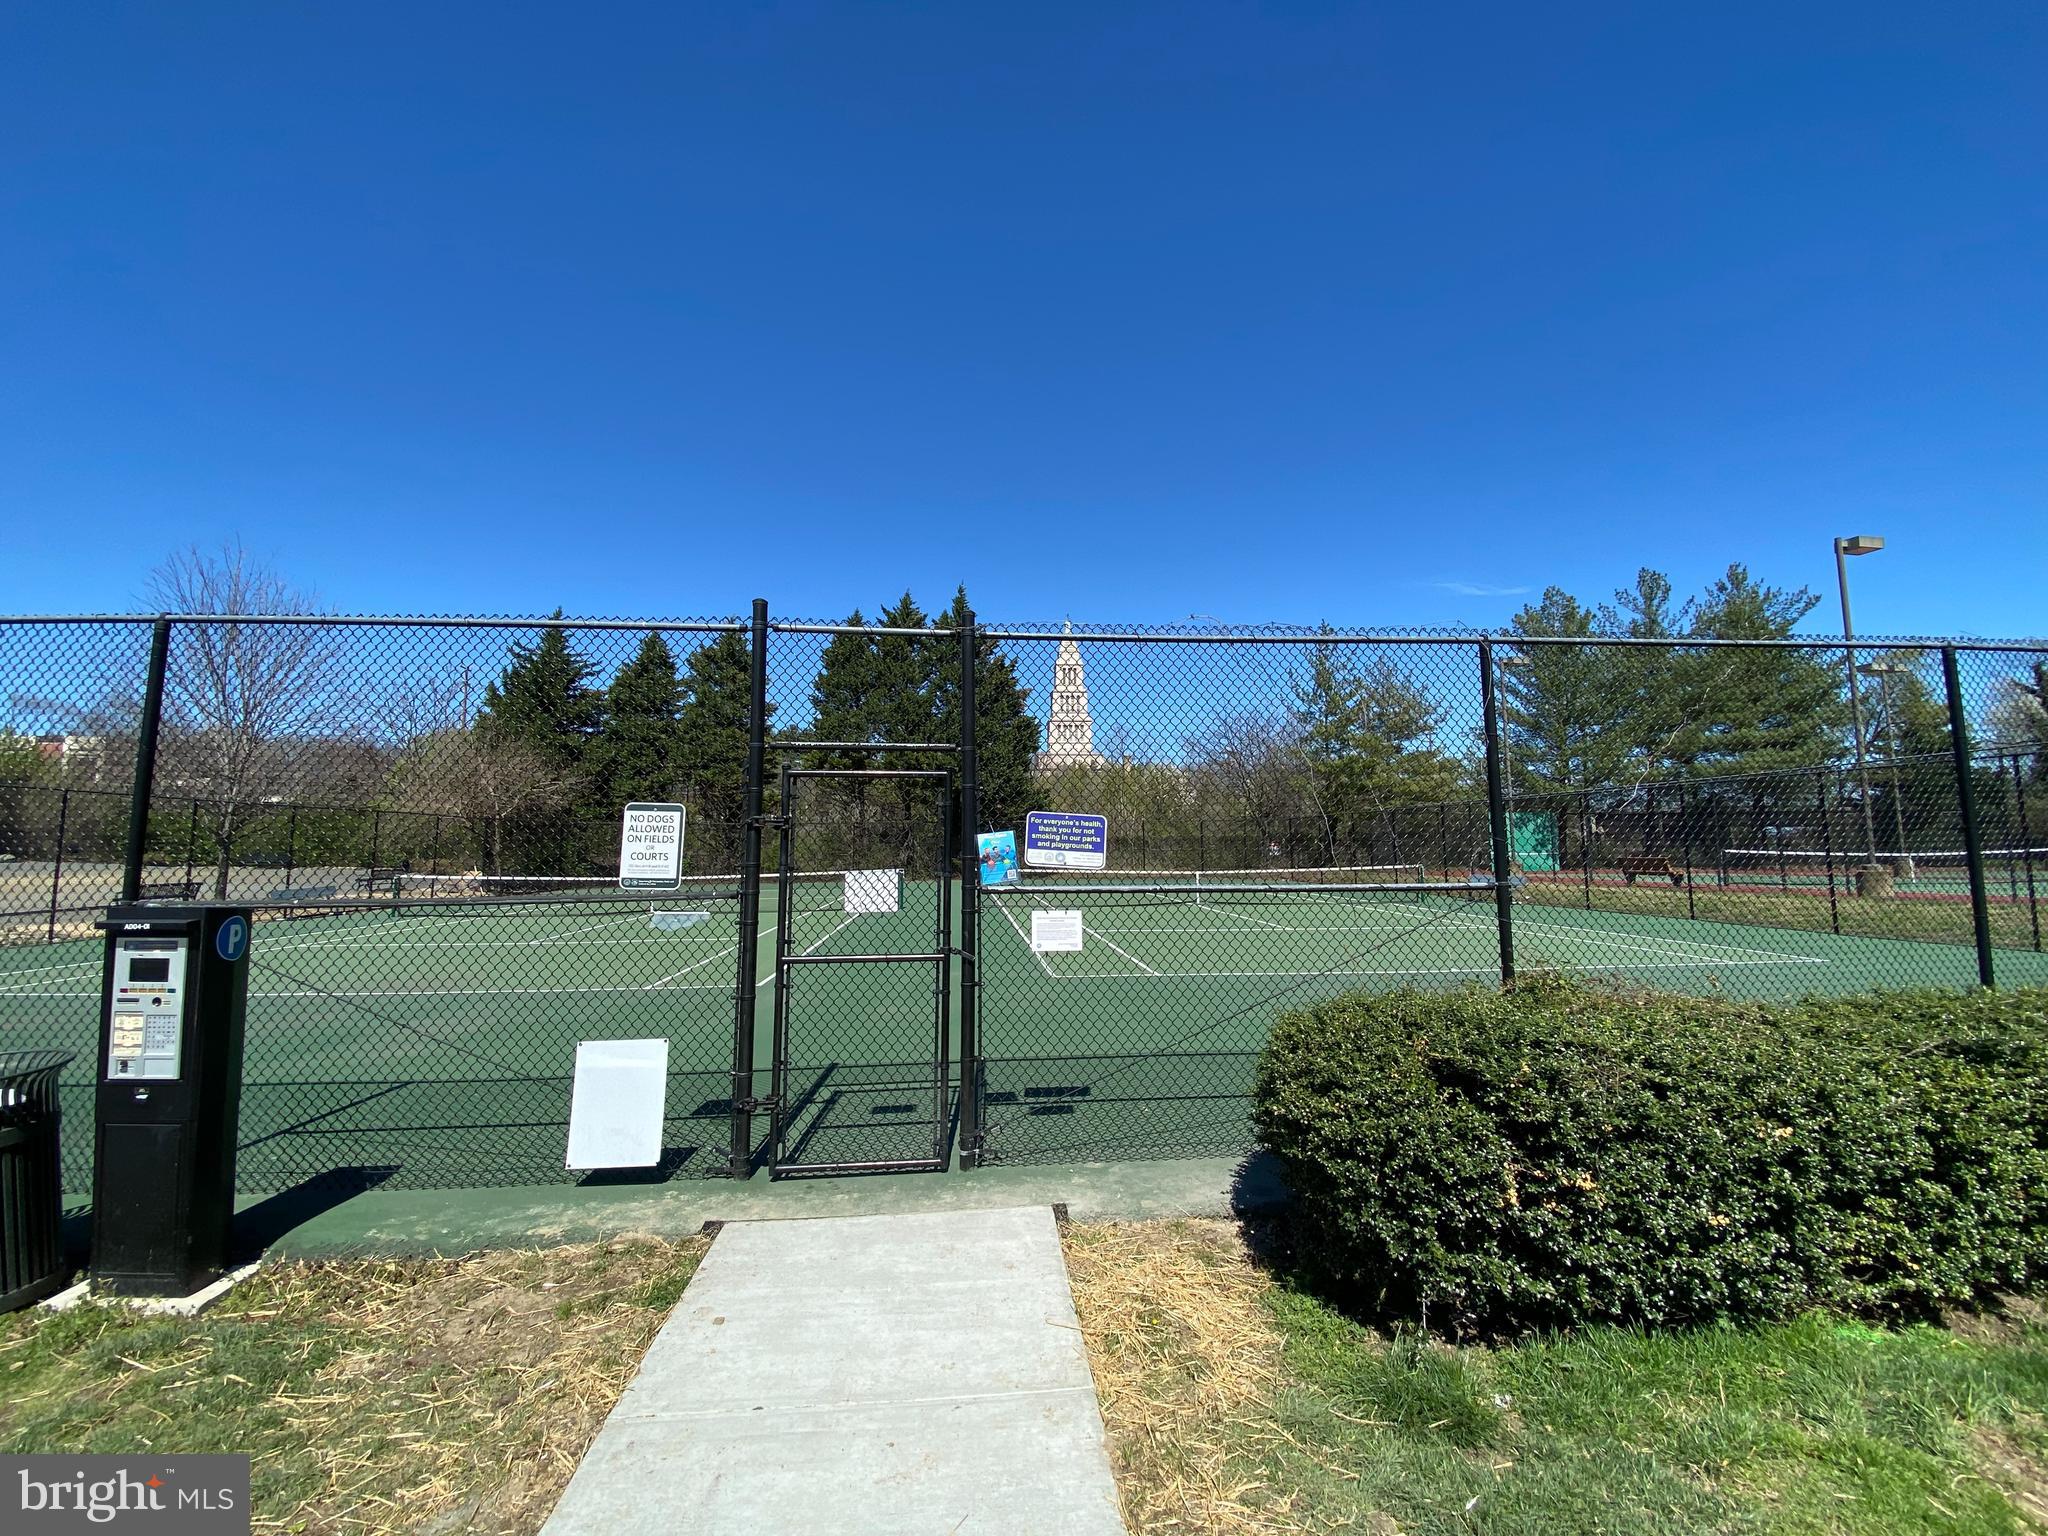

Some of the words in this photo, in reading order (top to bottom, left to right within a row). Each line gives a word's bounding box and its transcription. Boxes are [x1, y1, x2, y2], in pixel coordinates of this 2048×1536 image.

[647, 815, 674, 823] DOGS
[1043, 818, 1079, 826] everyone's
[1080, 820, 1103, 828] health,
[628, 825, 675, 833] ALLOWED
[627, 834, 642, 843] ON
[644, 835, 675, 843] FIELDS
[1051, 841, 1095, 849] playgrounds.
[630, 852, 669, 860] COURTS
[228, 924, 242, 954] P
